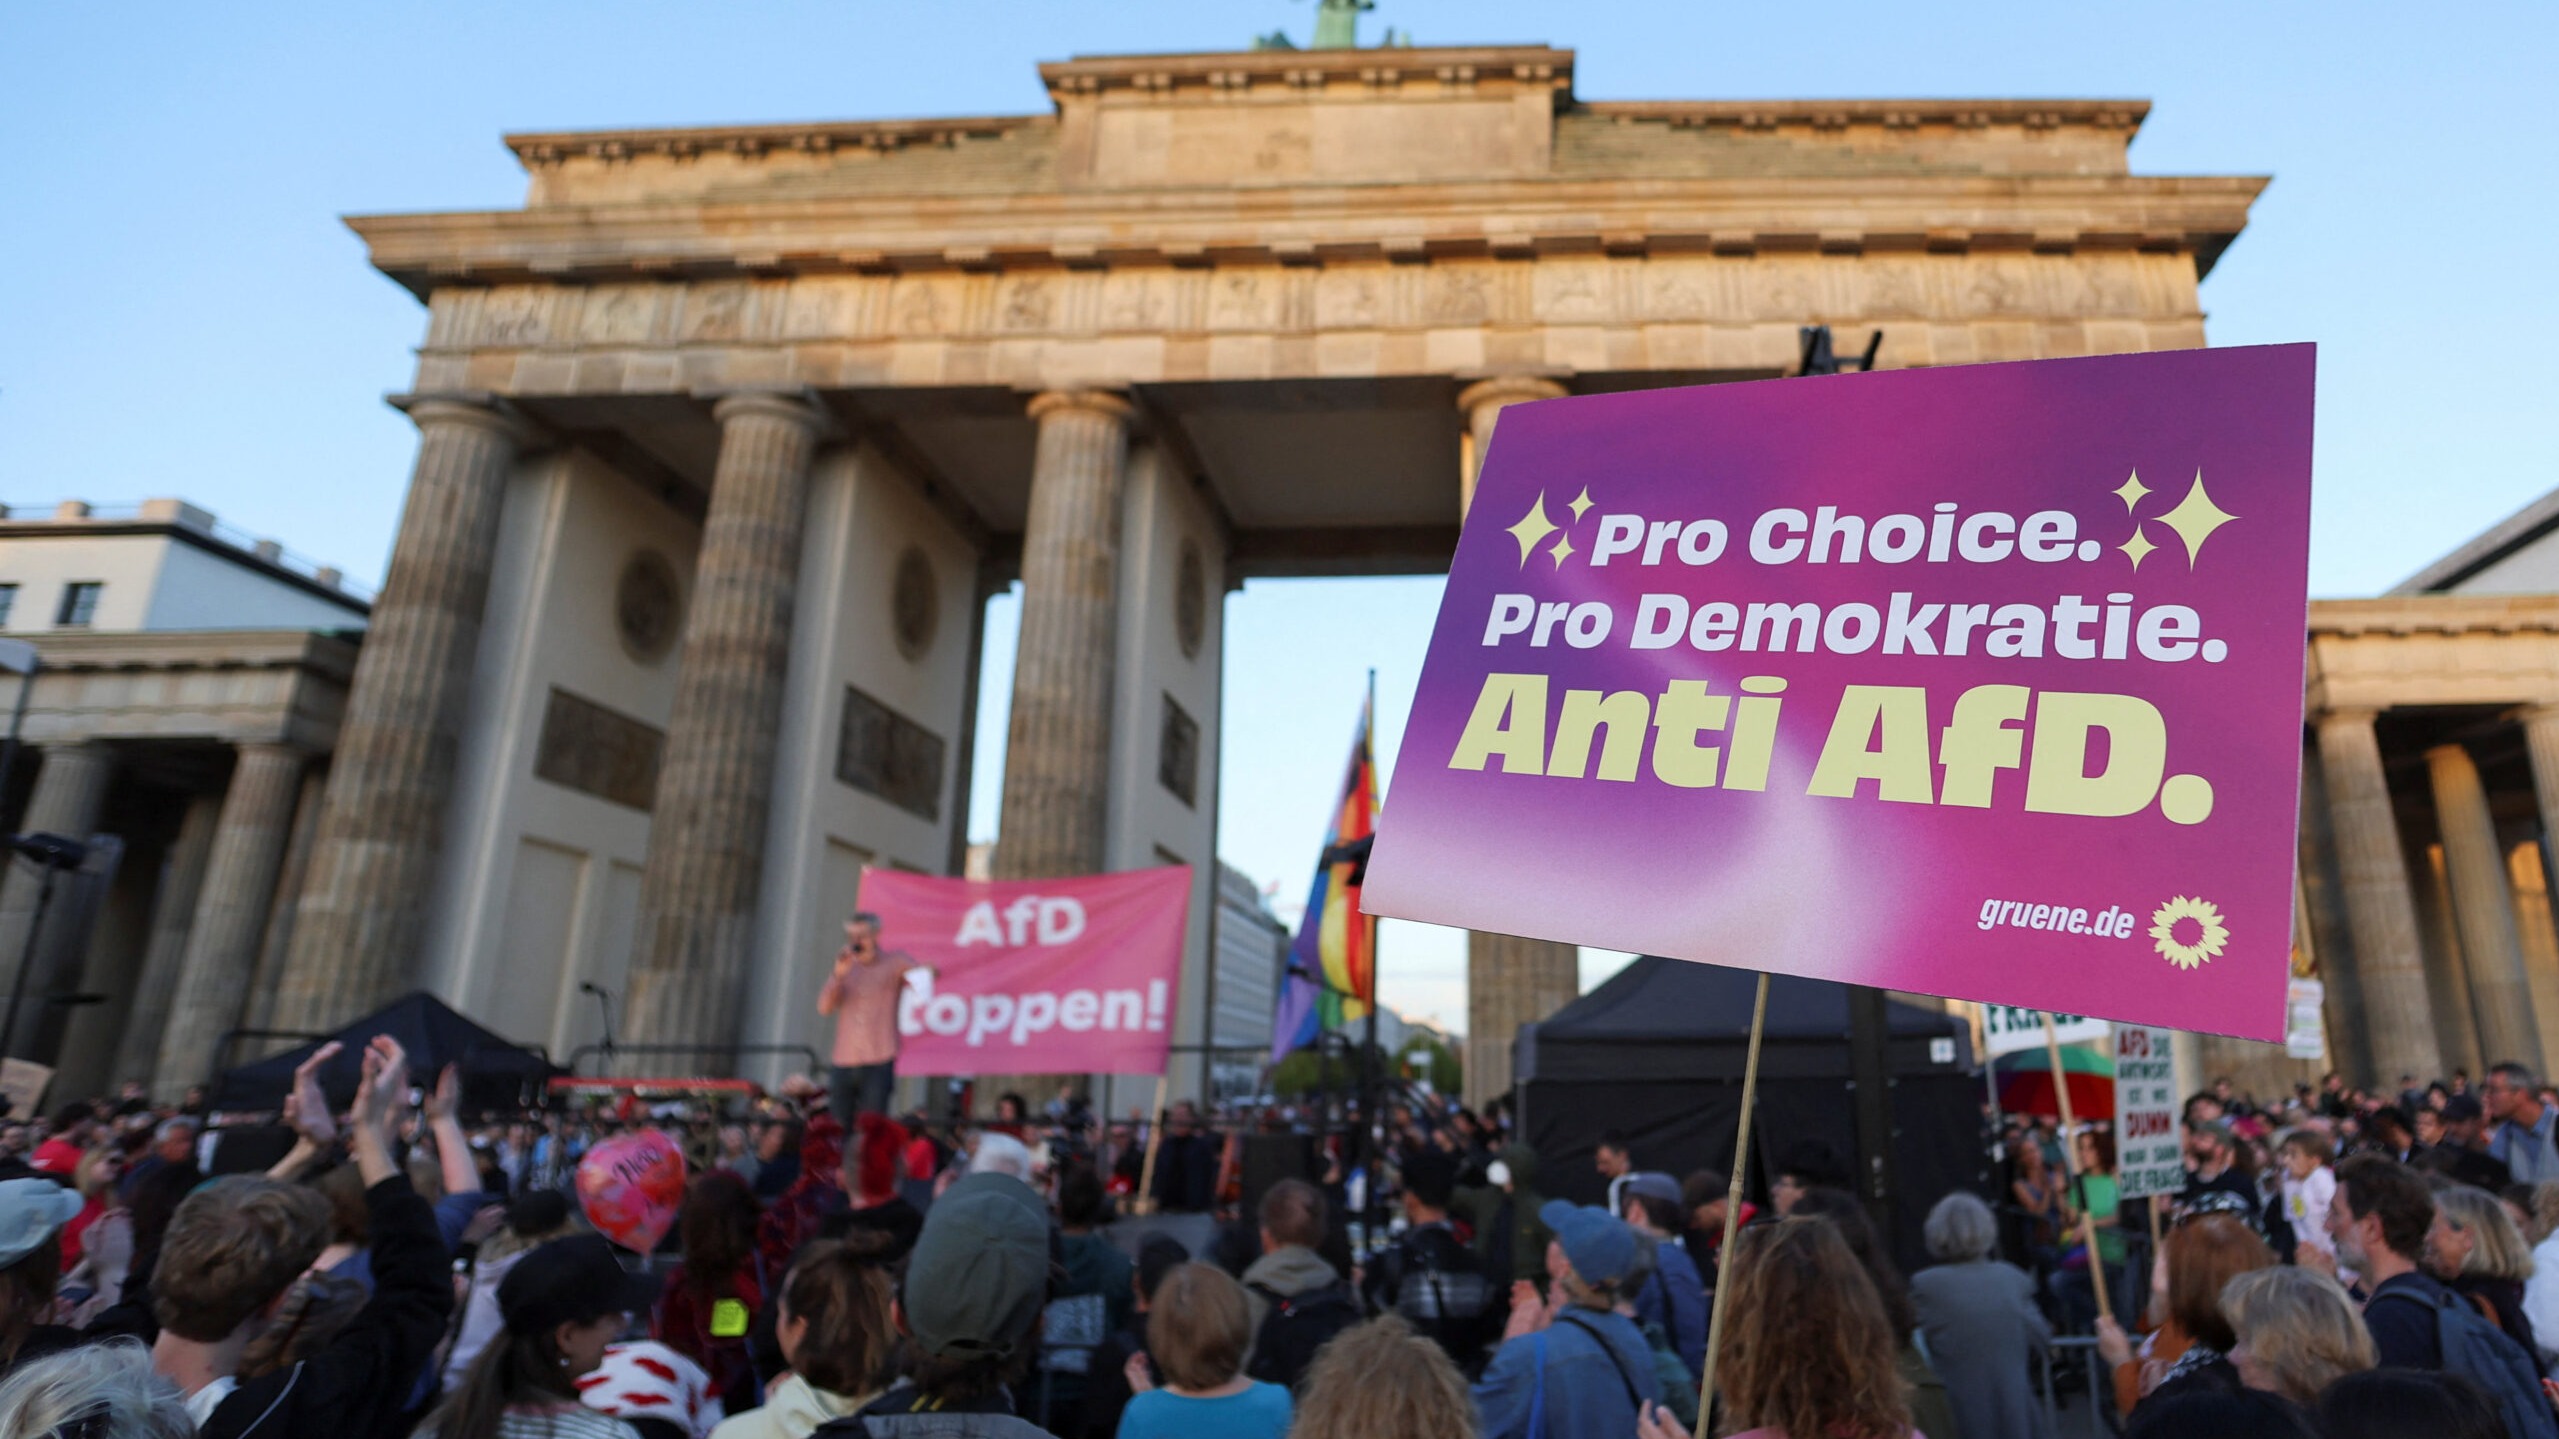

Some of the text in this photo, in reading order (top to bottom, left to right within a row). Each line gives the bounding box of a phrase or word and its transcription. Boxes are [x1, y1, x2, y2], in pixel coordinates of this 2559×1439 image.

[1590, 502, 2101, 567] Pro Choice.
[1481, 591, 2228, 663] Pro Demokratie.
[1447, 672, 2214, 825] Anti AfD.
[954, 895, 1087, 947] AfD
[1977, 898, 2136, 940] gruene.de
[898, 978, 1169, 1046] toppen!
